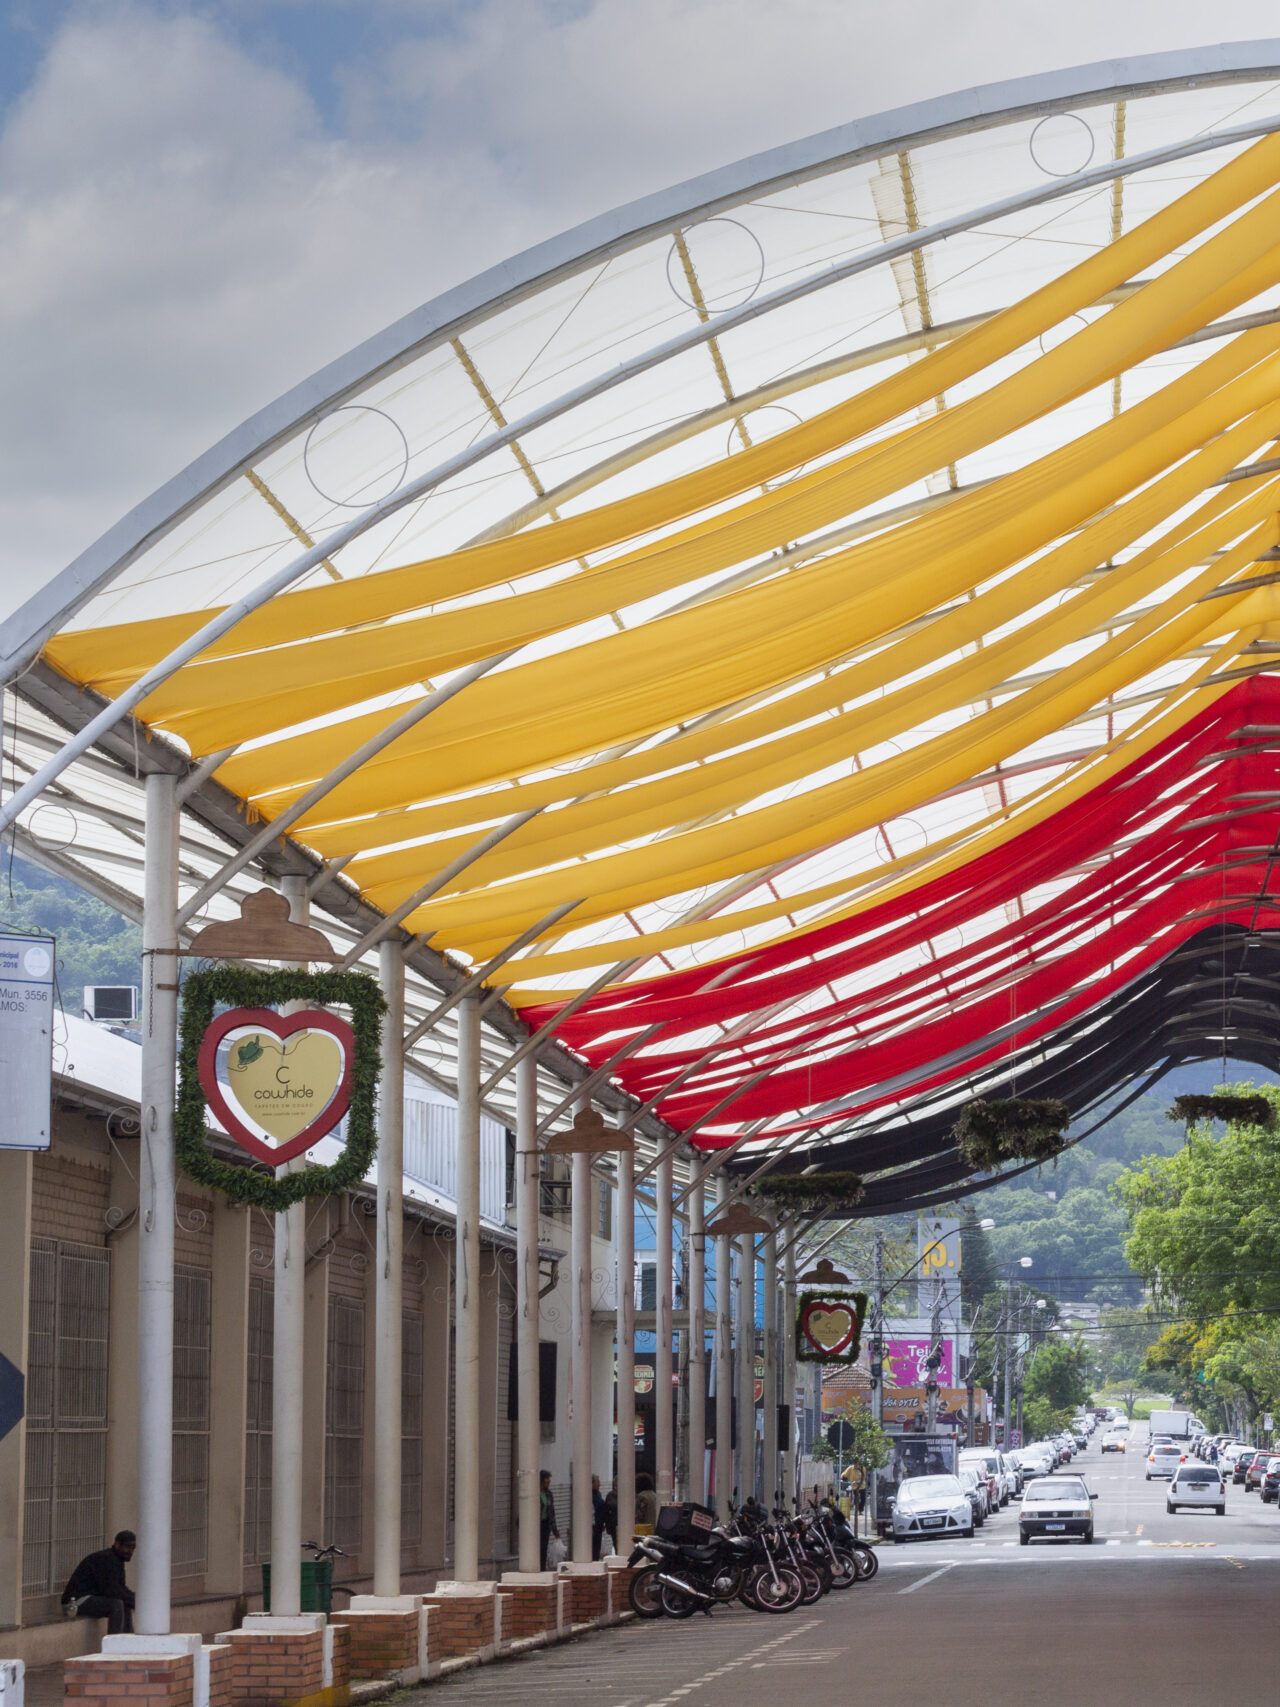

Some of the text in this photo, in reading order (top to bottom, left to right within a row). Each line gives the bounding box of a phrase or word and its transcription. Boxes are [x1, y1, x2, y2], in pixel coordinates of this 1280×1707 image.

[25, 990, 48, 1001] 3556
[0, 1001, 28, 1012] MOS:
[276, 1066, 290, 1084] C
[254, 1085, 314, 1099] cowhide
